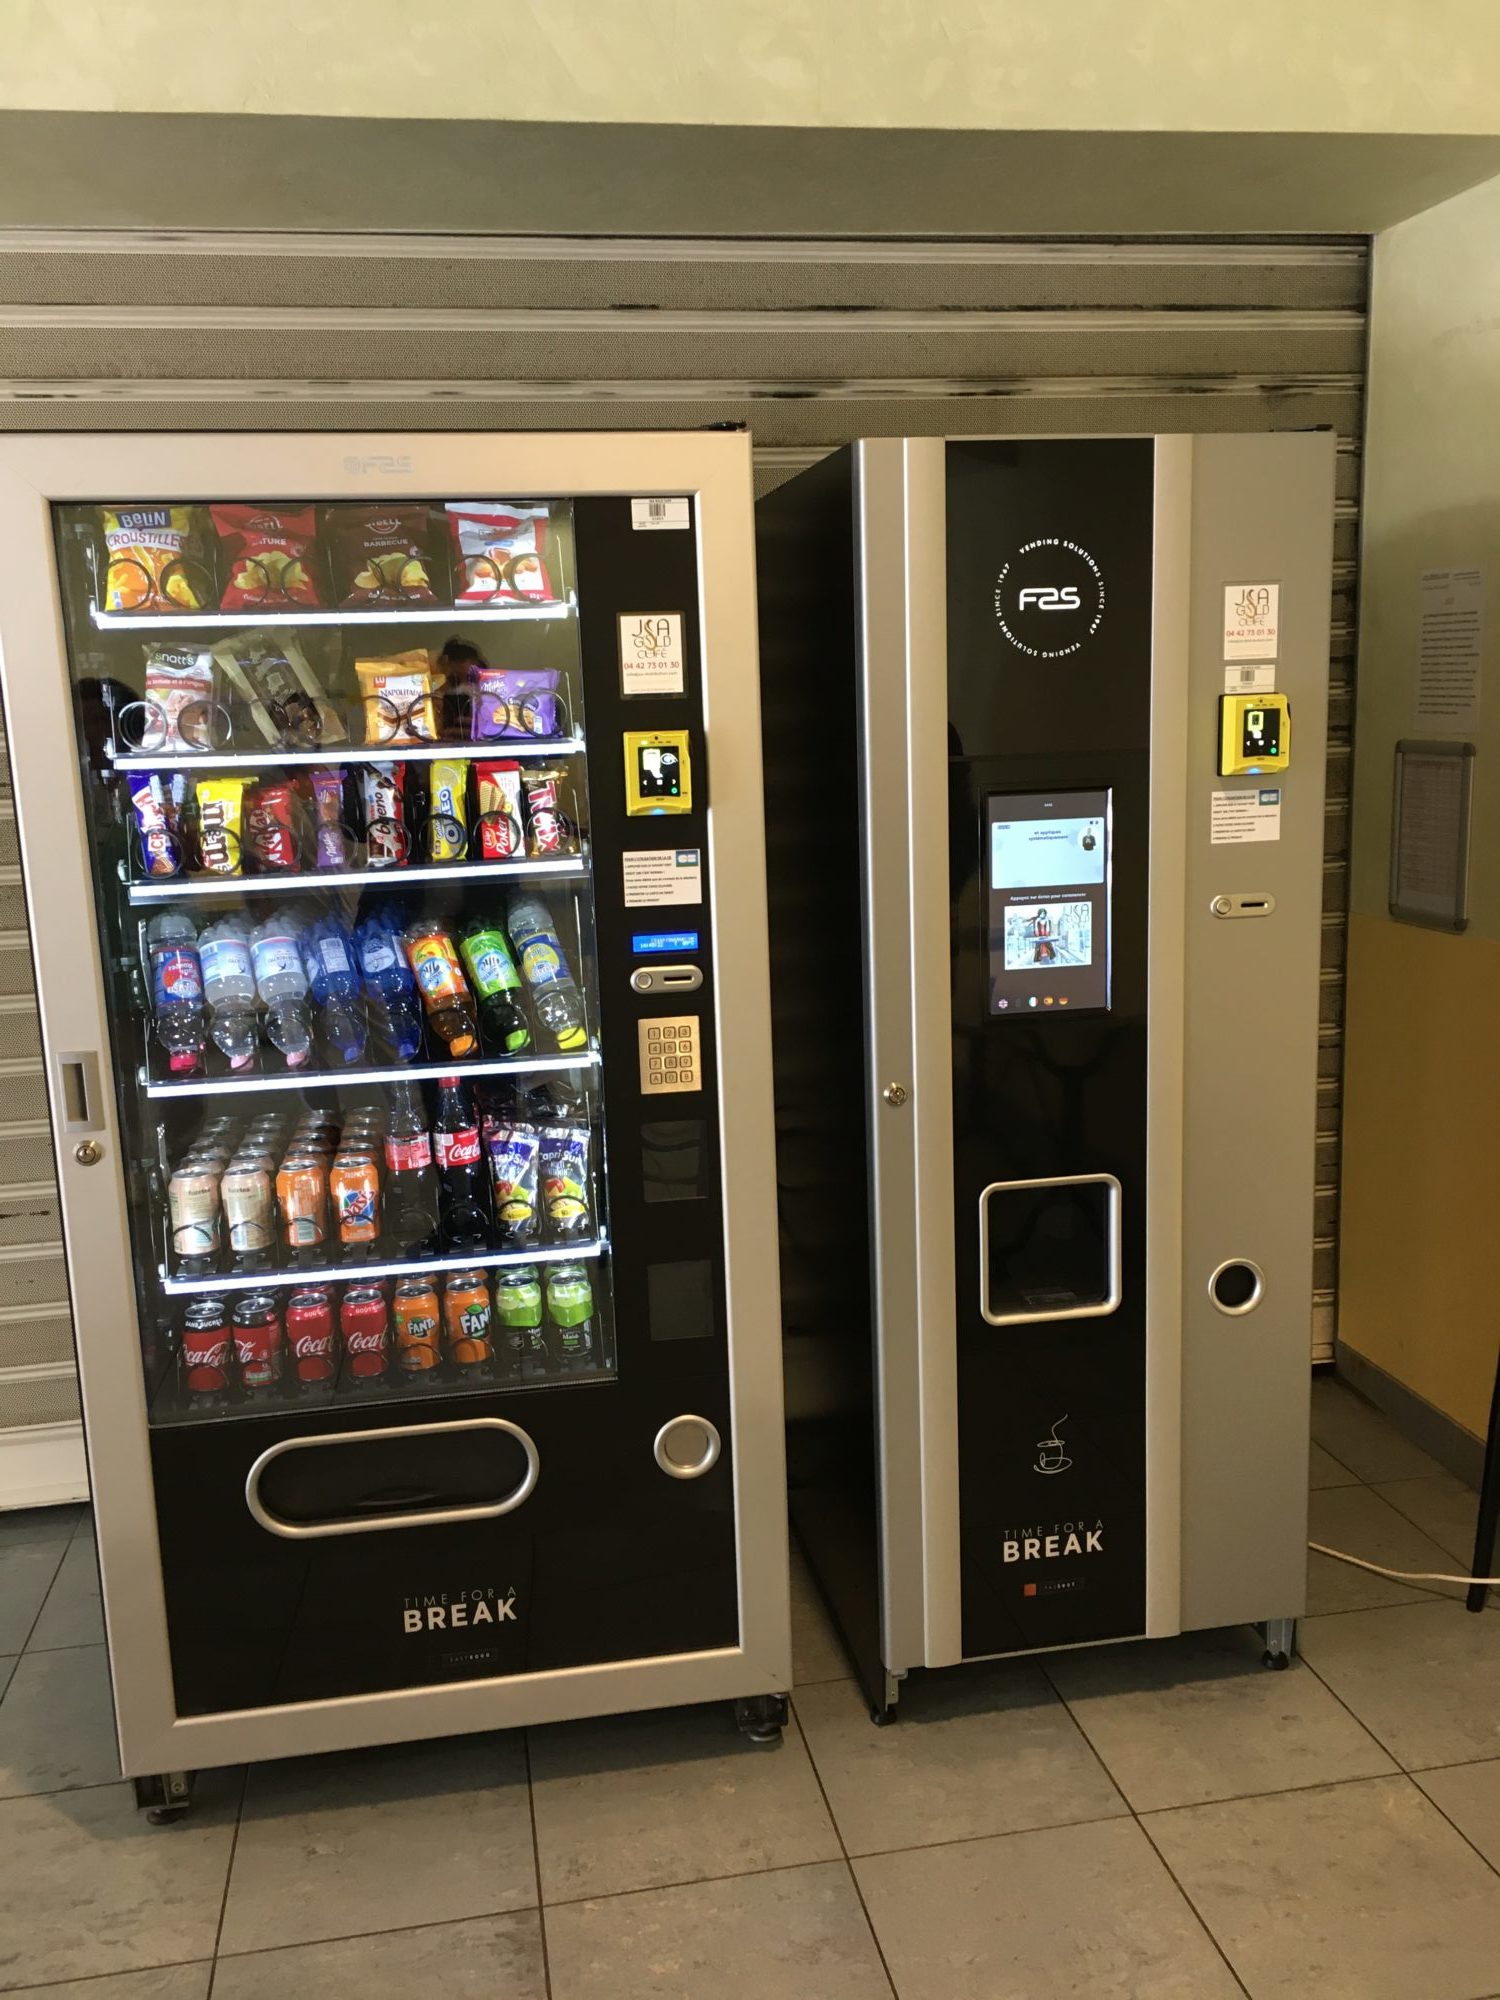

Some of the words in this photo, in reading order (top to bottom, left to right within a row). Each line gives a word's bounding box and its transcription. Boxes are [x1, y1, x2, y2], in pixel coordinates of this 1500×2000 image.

[1019, 538, 1060, 554] VENDING
[1063, 540, 1101, 577] SOLUTIONS
[999, 620, 1038, 656] SOLUTIONS
[1042, 642, 1081, 658] VENDING
[1004, 1526, 1043, 1540] TIME
[1054, 1521, 1085, 1534] FOR
[1095, 1519, 1104, 1529] A
[1003, 1530, 1104, 1563] BREAK
[404, 1593, 449, 1609] TIME
[461, 1588, 495, 1603] FOR
[507, 1586, 517, 1597] A
[403, 1597, 518, 1633] BREAK
